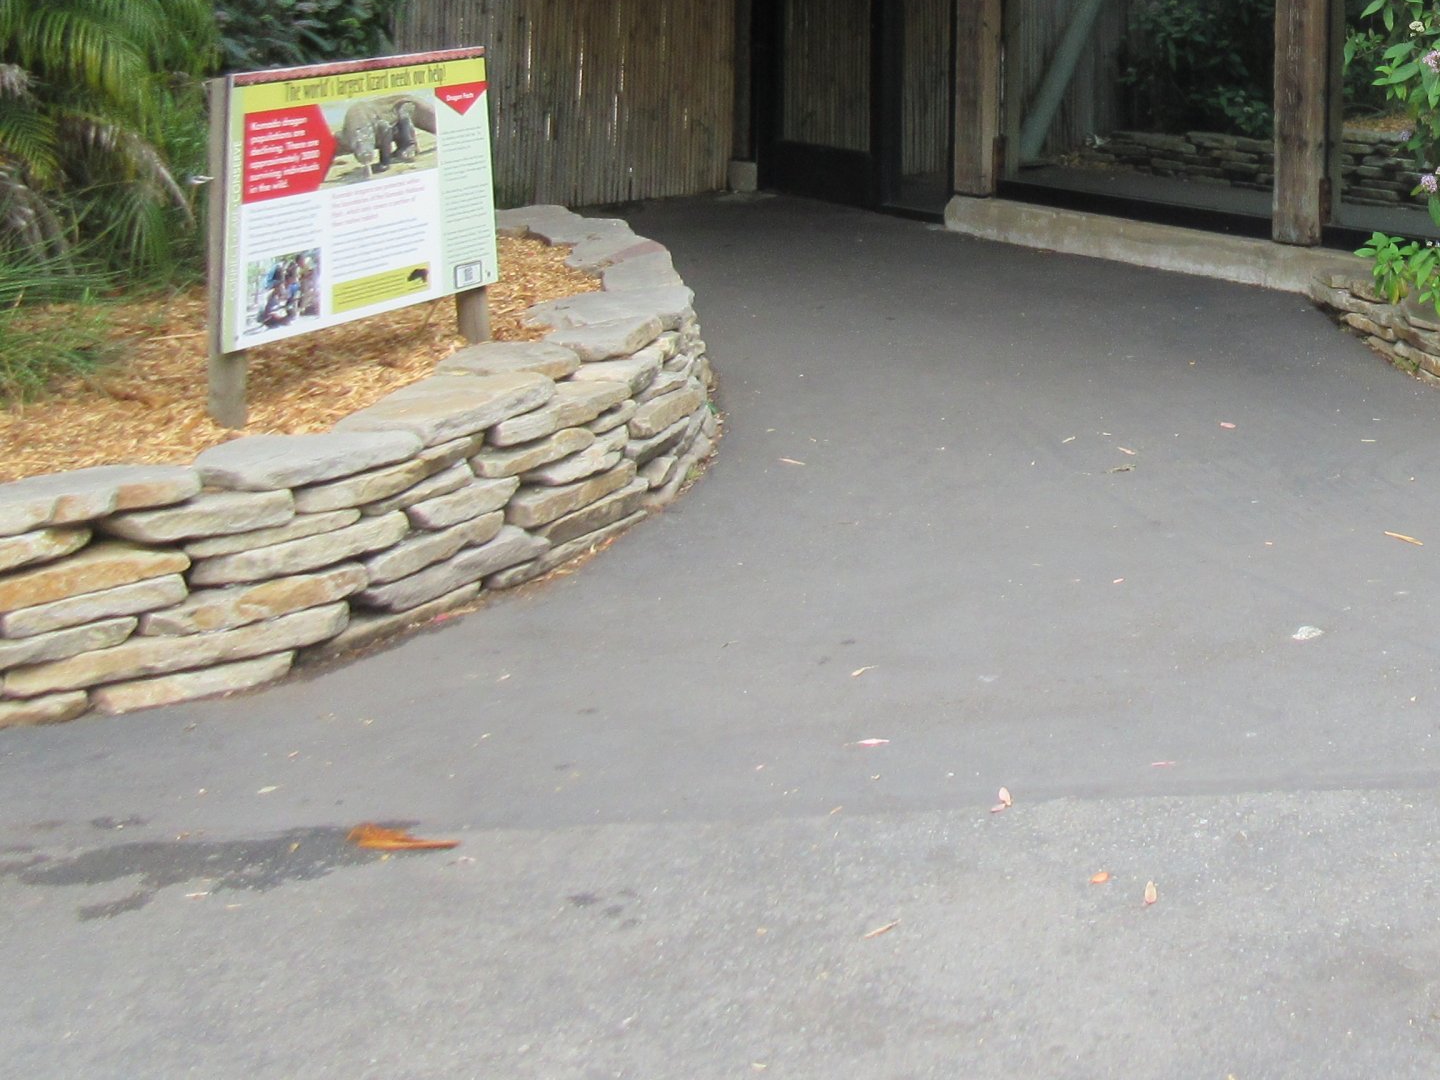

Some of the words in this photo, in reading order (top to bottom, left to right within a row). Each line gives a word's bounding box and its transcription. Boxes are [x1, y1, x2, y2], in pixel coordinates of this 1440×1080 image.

[284, 82, 300, 102] The
[303, 77, 334, 99] world's
[337, 76, 364, 98] largest
[366, 71, 388, 91] lizard
[390, 67, 411, 87] needs
[413, 70, 426, 85] our
[428, 63, 447, 86] help!
[250, 119, 281, 131] Komodo
[232, 142, 241, 202] CONSERVE
